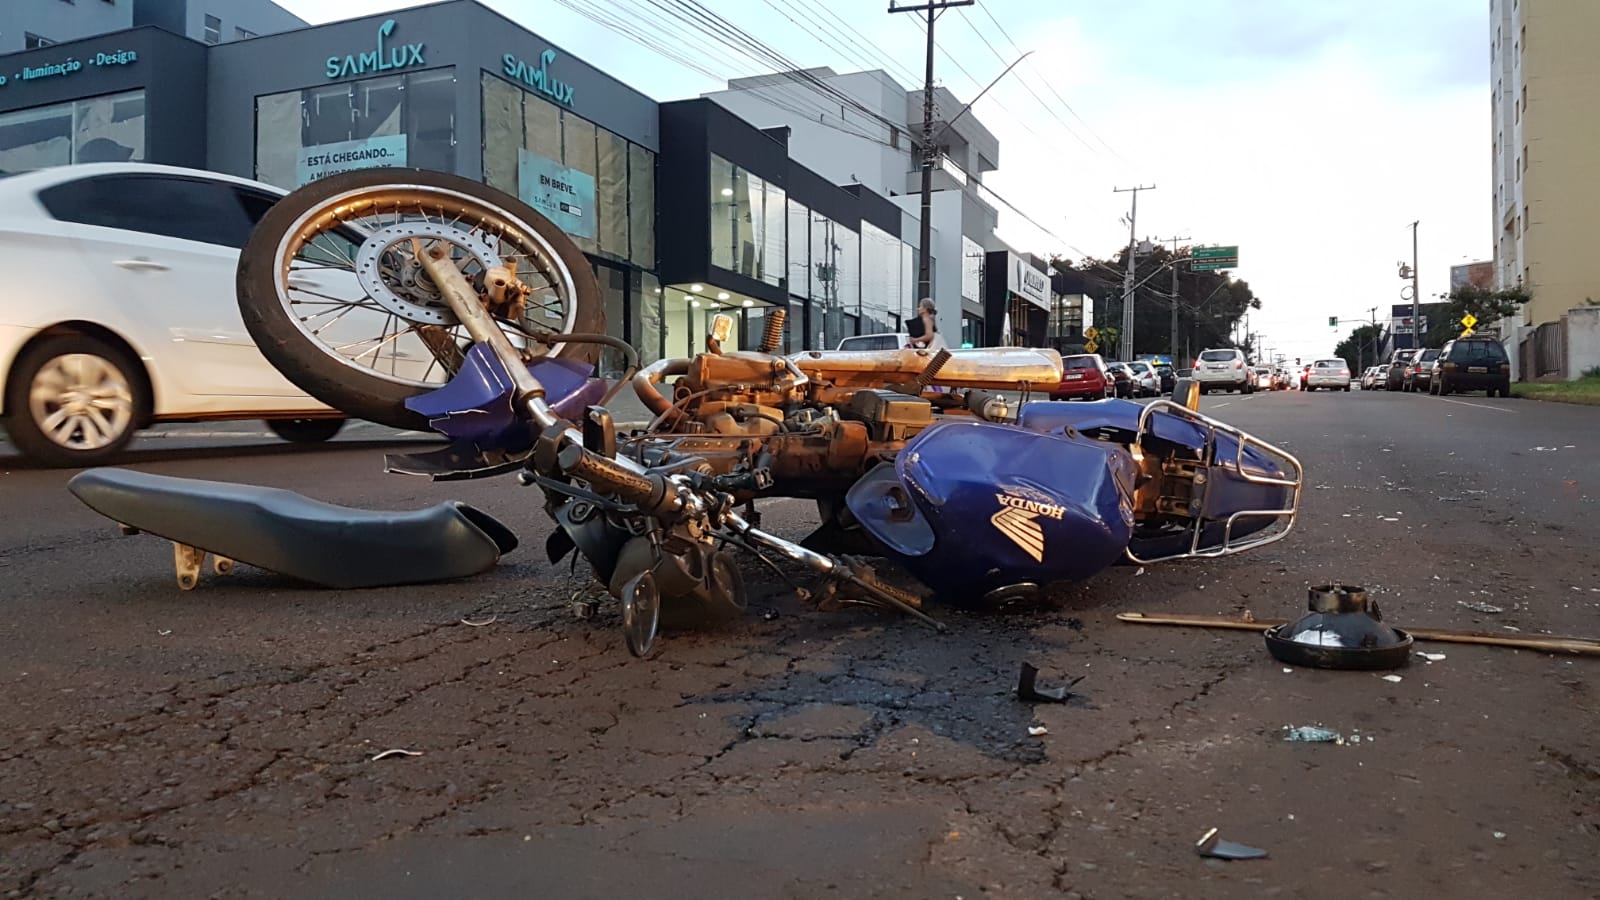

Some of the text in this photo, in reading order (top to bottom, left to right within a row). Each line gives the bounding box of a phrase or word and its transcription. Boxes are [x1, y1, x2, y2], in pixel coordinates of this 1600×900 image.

[326, 19, 424, 78] SAMLUX
[23, 57, 82, 80] Iluminação
[96, 49, 137, 66] Design
[502, 49, 575, 107] SAMLUX
[307, 147, 395, 167] ESTÁ CHEGANDO...
[539, 174, 551, 187] EM
[995, 493, 1067, 520] HONDA
